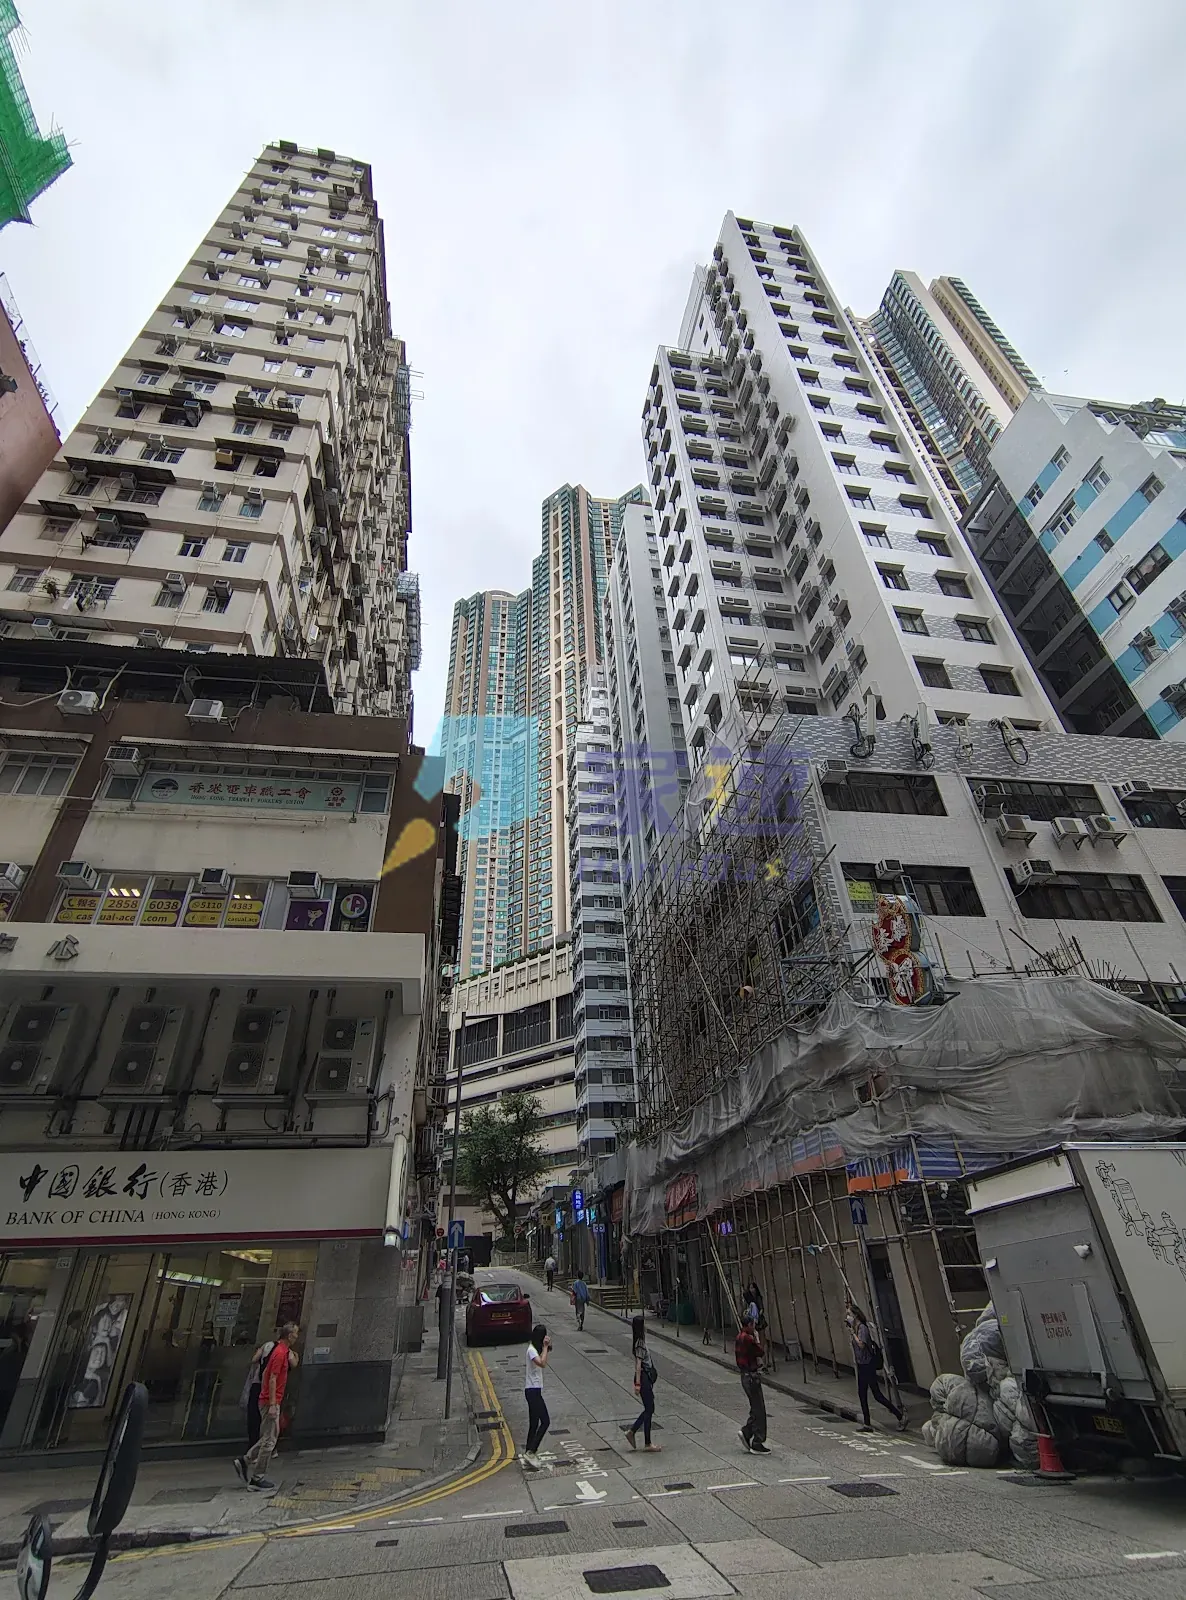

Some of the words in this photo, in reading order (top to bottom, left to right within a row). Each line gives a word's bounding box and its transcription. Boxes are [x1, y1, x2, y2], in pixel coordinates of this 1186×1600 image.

[189, 782, 312, 799] 香港電車職工會
[107, 899, 138, 909] 2858
[149, 900, 179, 910] 6038
[200, 902, 222, 910] 5110
[5, 1212, 57, 1226] BANK
[60, 1211, 84, 1224] OF
[88, 1209, 145, 1224] CHINA
[151, 1211, 185, 1221] (HONG
[188, 1209, 222, 1220] KONG)
